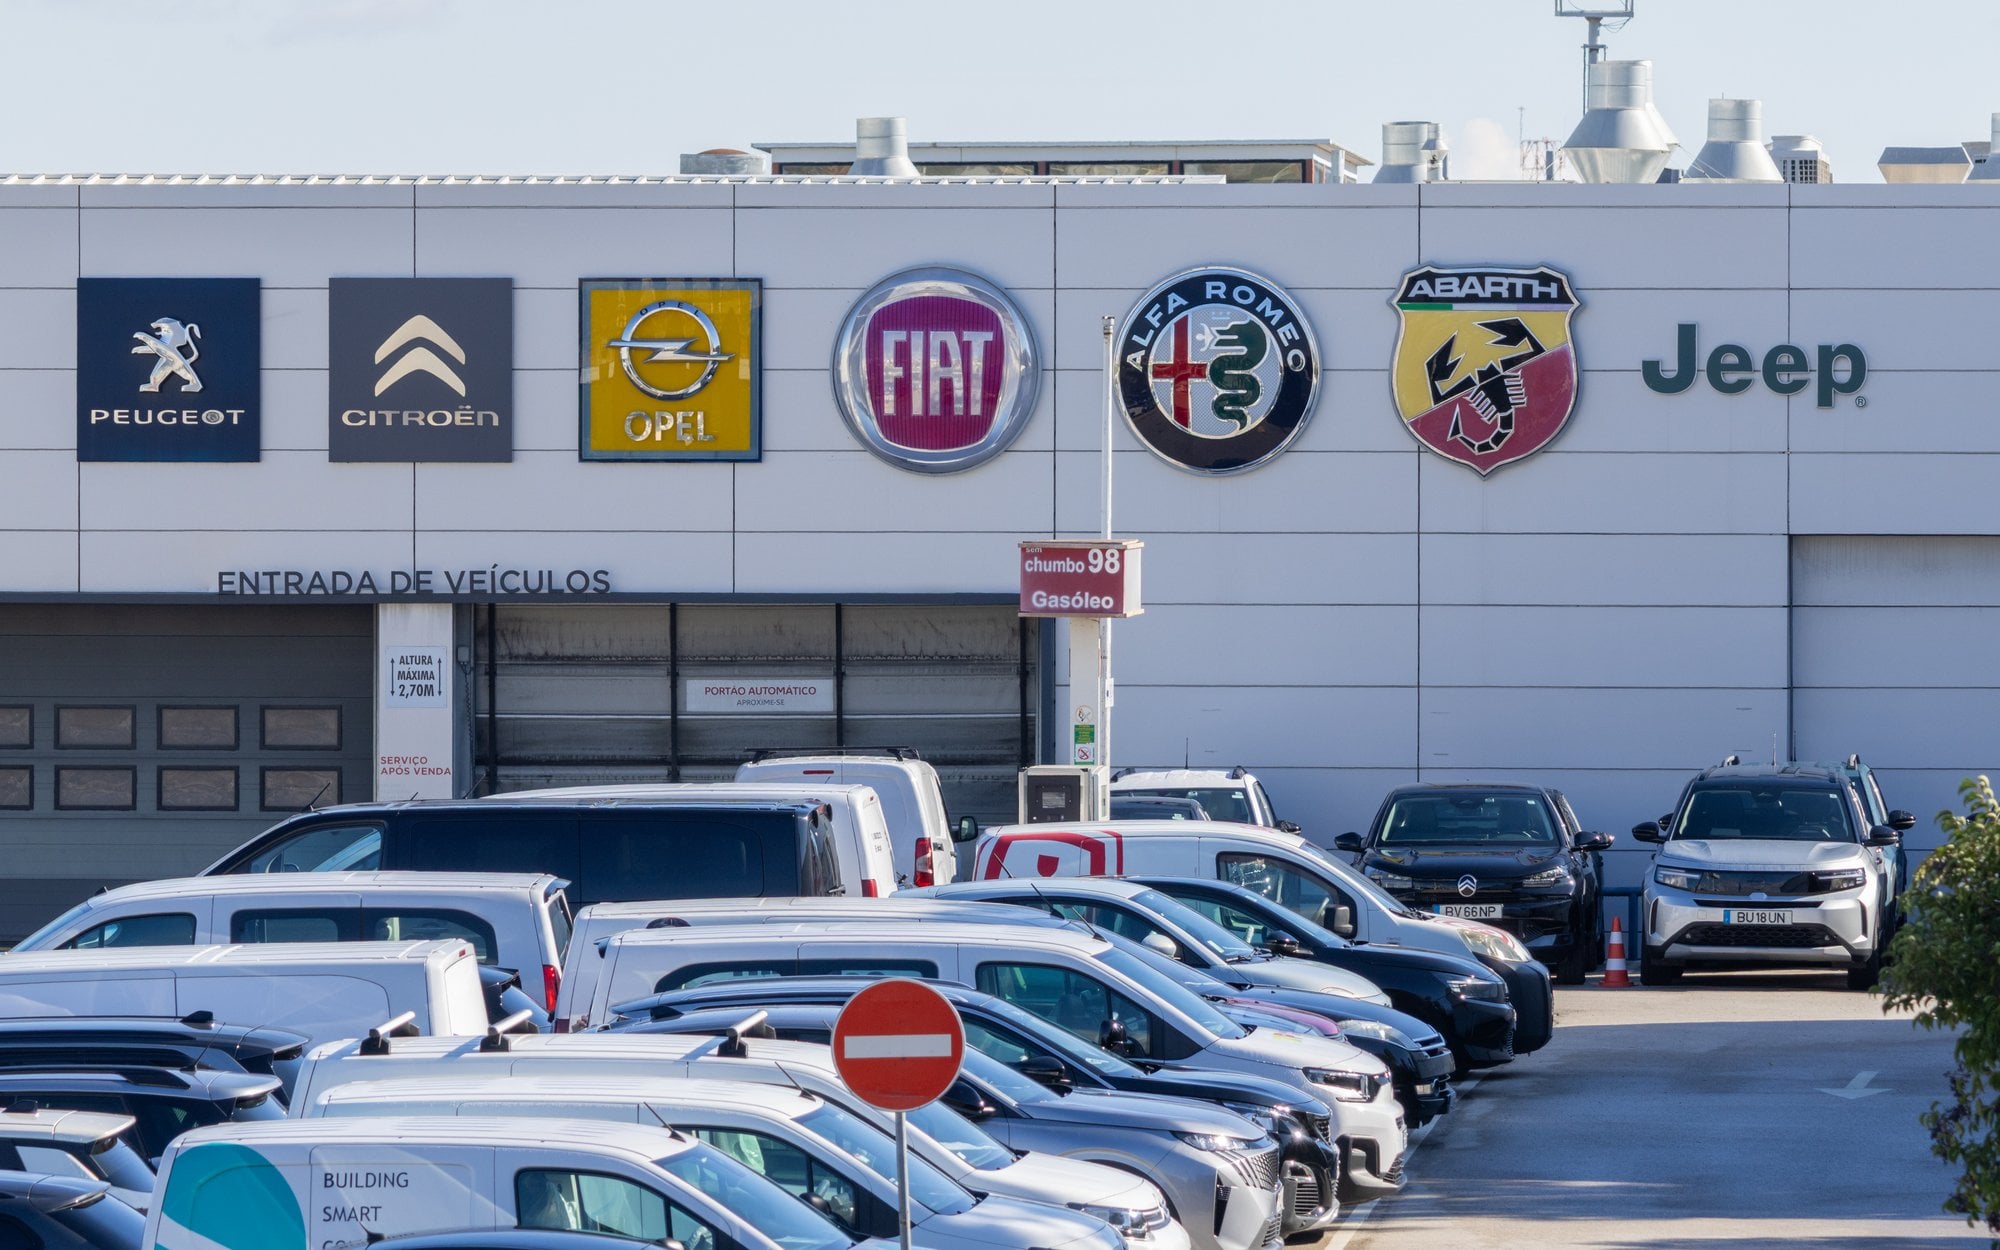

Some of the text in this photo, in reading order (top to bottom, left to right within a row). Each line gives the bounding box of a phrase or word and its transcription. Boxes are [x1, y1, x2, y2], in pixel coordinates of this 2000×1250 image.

[1408, 276, 1557, 298] ABARTH
[639, 301, 701, 318] OPEL
[1126, 281, 1306, 372] ALFA ROMEO
[882, 330, 994, 417] FIAT
[1641, 322, 1868, 409] Jeep
[90, 409, 245, 425] PEUGEOT
[624, 410, 716, 442] OPEL
[1025, 548, 1120, 574] chumbo 98
[217, 563, 611, 595] ENTRADA DE VEÍCULOS
[1031, 590, 1114, 609] Gasóleo
[399, 655, 433, 666] ALTURA
[397, 667, 435, 681] MÁXIMA
[398, 684, 434, 699] 2,70M
[704, 685, 817, 696] PORTÃO AUTOMÁTICO
[380, 756, 428, 766] SERVIÇO
[380, 765, 451, 776] APÓS VENDA
[323, 1171, 409, 1189] BUILDING
[322, 1205, 382, 1223] SMART
